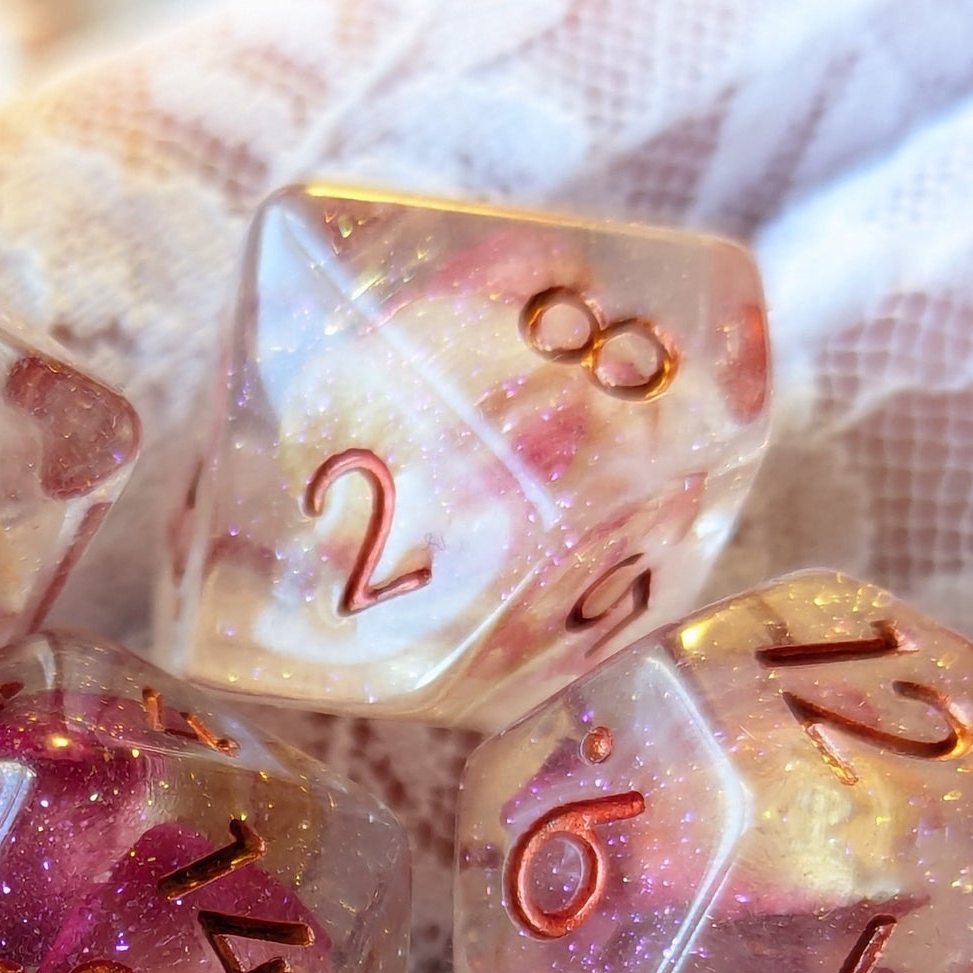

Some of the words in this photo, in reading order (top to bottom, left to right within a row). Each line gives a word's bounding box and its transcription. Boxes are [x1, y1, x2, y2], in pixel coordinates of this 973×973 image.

[519, 286, 678, 401] 8
[301, 447, 433, 617] 2
[755, 618, 973, 784] 12
